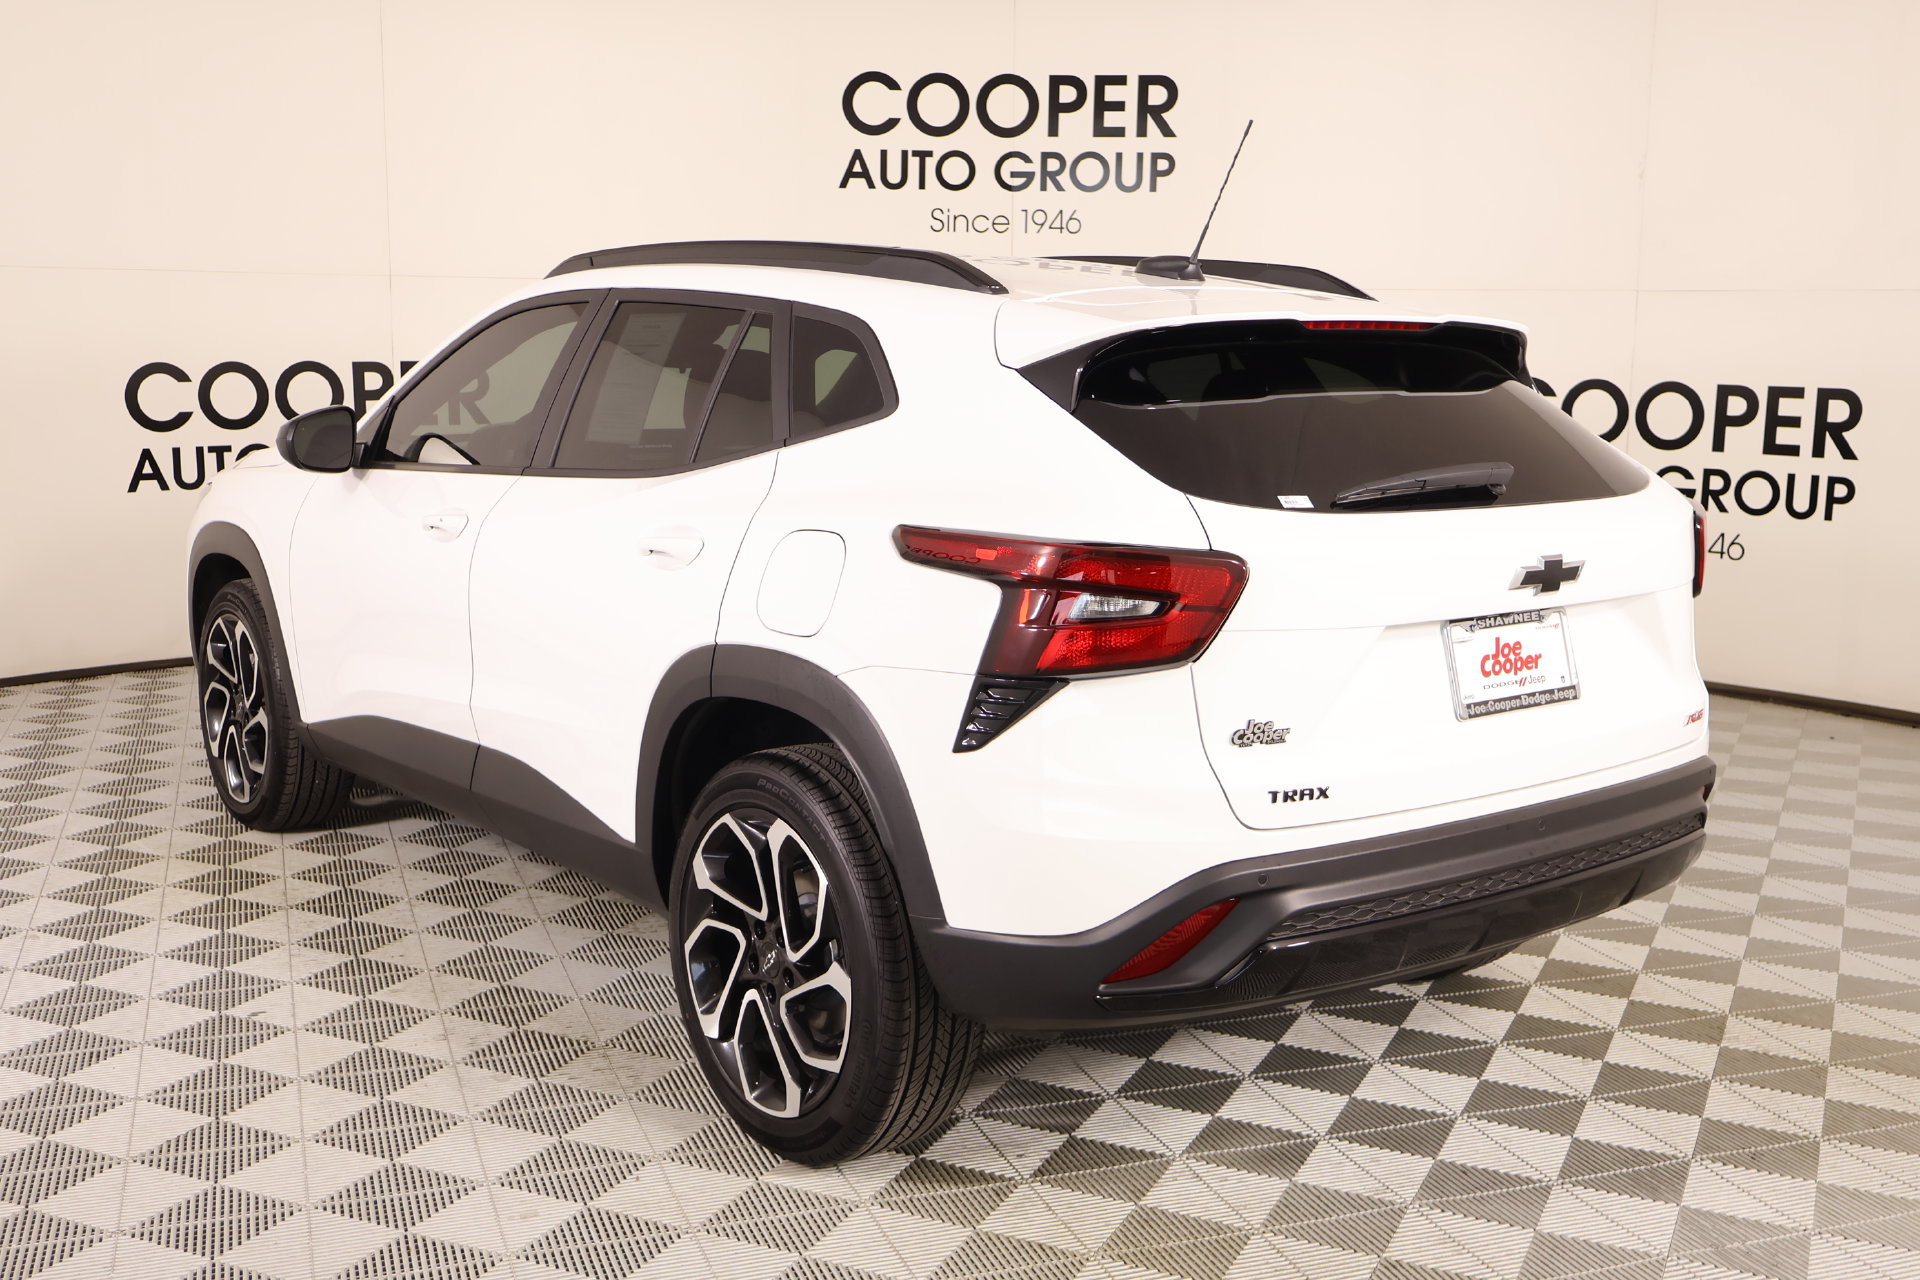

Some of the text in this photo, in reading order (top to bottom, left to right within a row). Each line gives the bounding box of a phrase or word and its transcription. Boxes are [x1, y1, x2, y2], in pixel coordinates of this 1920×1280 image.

[841, 71, 1179, 138] COOPER
[839, 148, 1176, 193] AUTO GROUP
[930, 207, 1082, 234] Since 1946
[1531, 377, 1863, 460] OOPER
[1478, 611, 1540, 628] SHAWNEE
[1492, 637, 1522, 660] Joe
[1480, 653, 1542, 677] Cooper
[1483, 674, 1546, 690] DODGE Jeep
[1231, 728, 1290, 745] Cooper
[1247, 719, 1274, 734] Joe
[1267, 786, 1330, 803] TRAX
